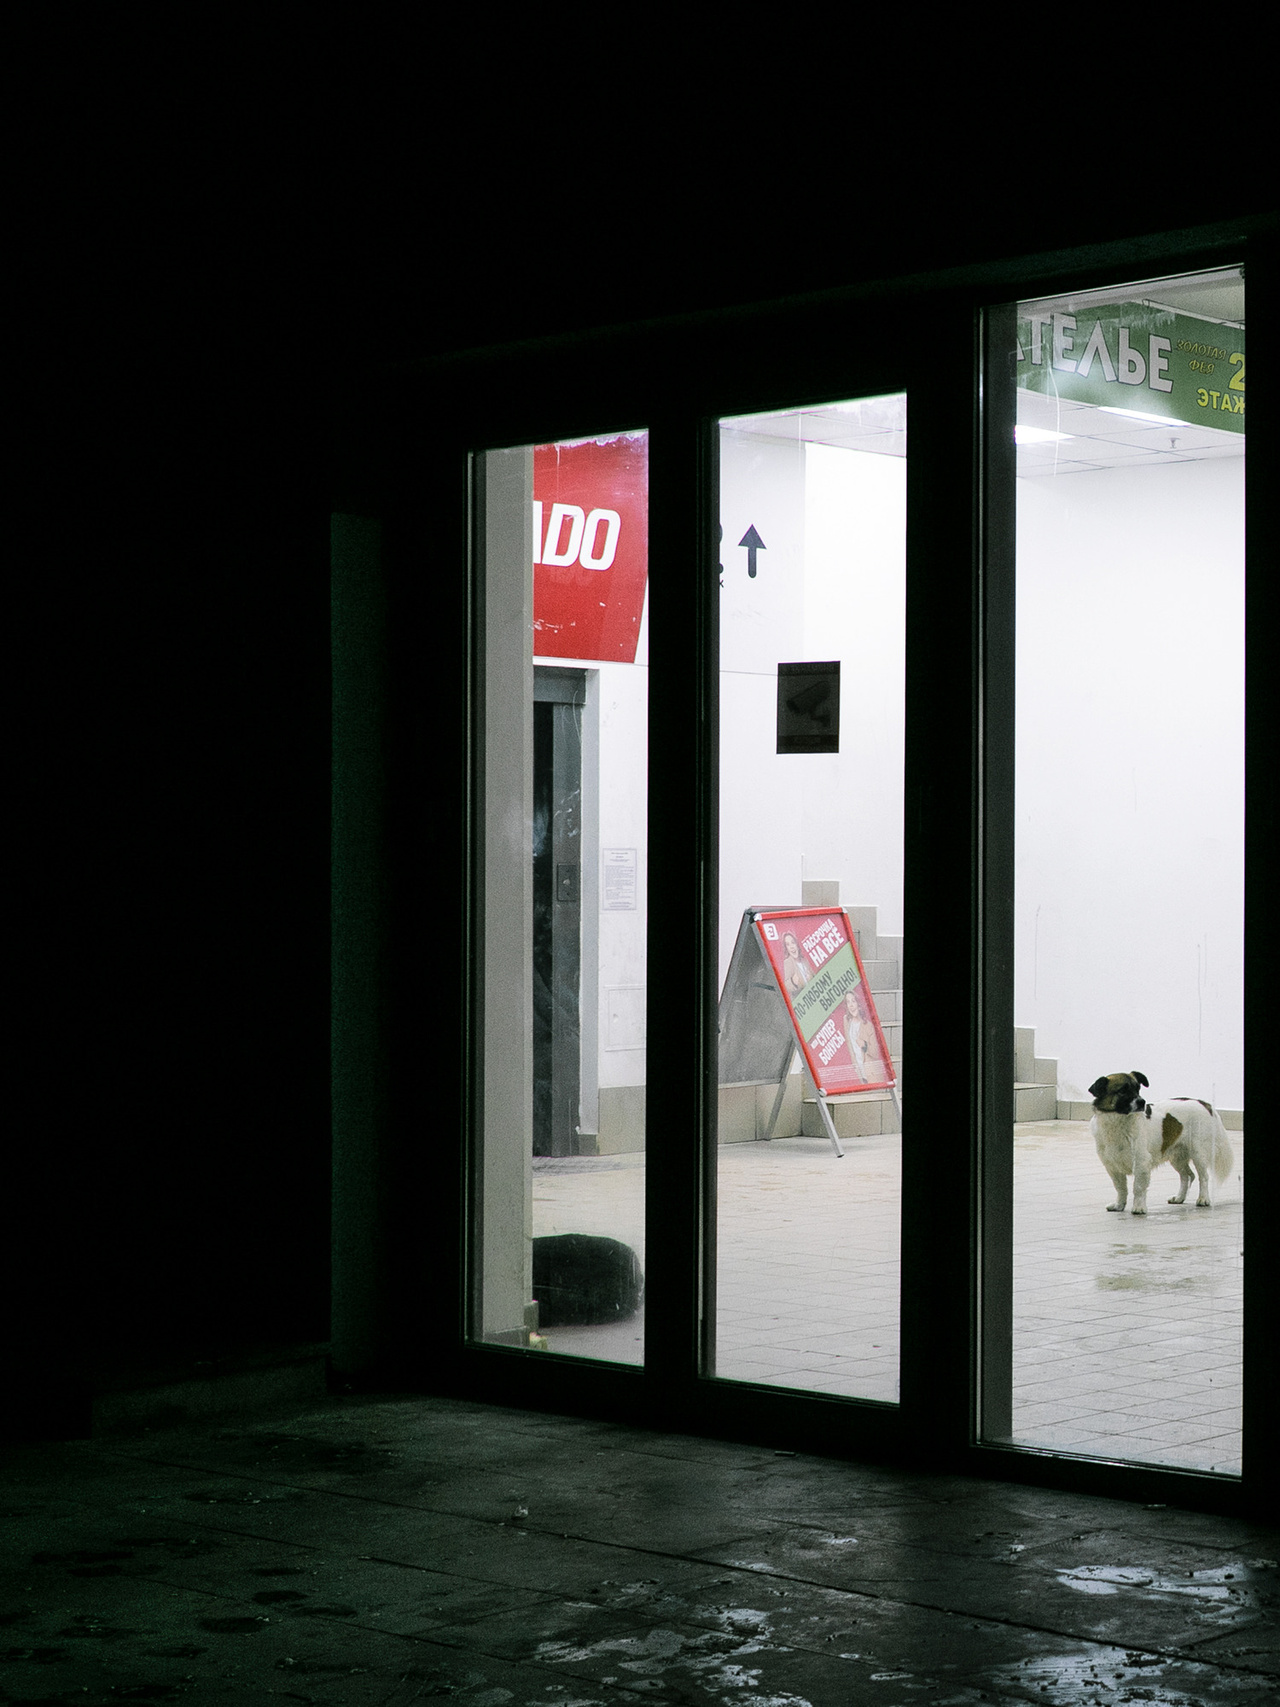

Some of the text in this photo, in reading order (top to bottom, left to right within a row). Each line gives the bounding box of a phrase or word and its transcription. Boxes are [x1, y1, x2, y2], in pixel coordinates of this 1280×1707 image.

[1176, 338, 1227, 360] ЗОЛОТАЯ
[1188, 359, 1215, 375] ФЕЯ
[1228, 352, 1245, 391] 2
[802, 918, 835, 953] РАССРОЧКА
[809, 948, 826, 968] НА
[794, 971, 833, 1020] ПО-ЛЮБОМУ
[819, 967, 858, 1012] ВЫГОДНО!
[815, 1018, 837, 1047] СУПЕР
[818, 1030, 846, 1066] БОНУСЫ
